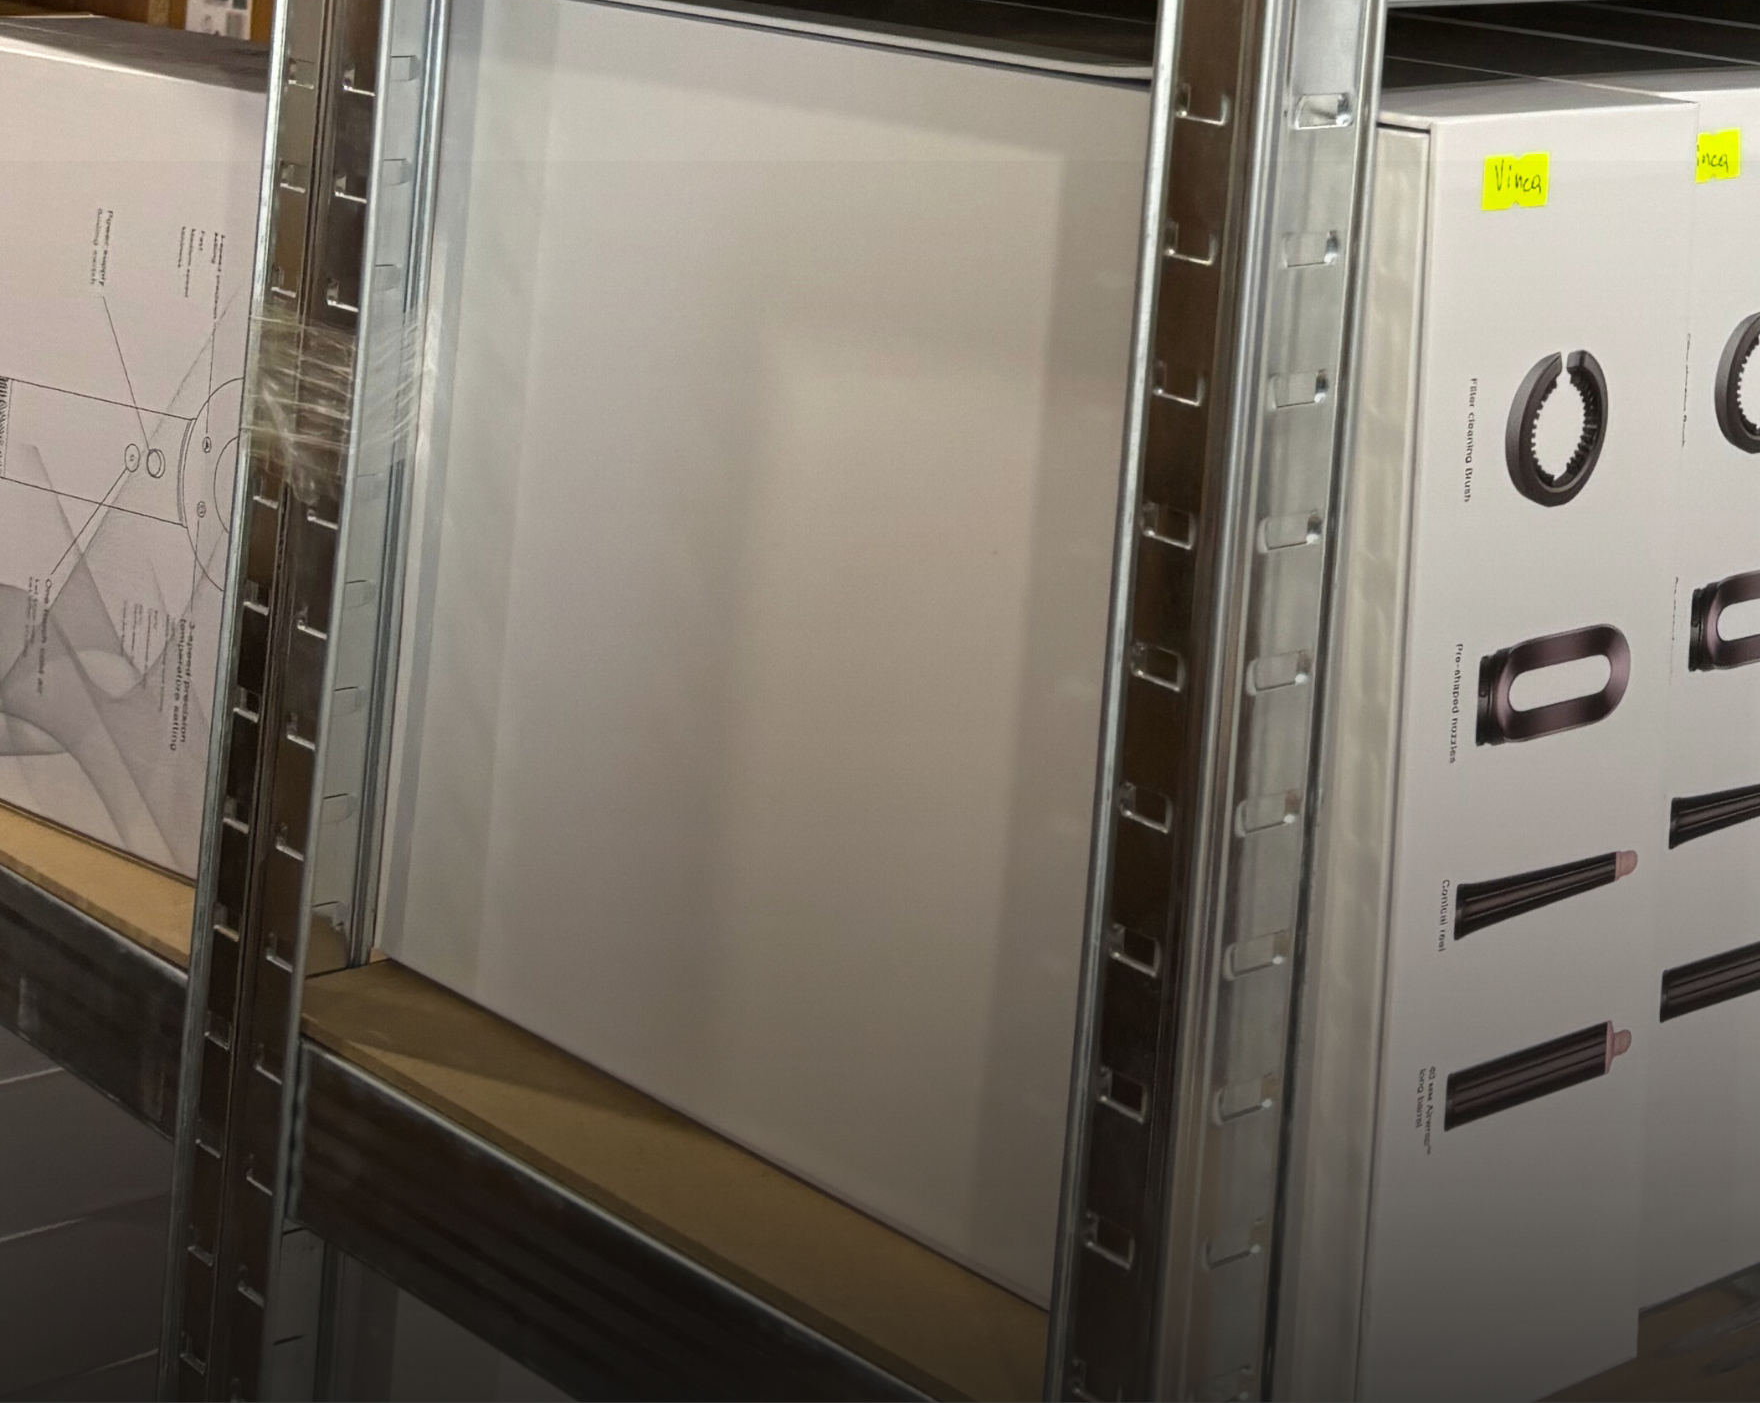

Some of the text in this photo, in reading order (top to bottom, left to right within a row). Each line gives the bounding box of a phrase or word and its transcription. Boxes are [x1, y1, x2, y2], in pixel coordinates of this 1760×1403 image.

[1696, 144, 1729, 173] inca
[1465, 412, 1475, 464] cleaning
[174, 618, 187, 701] temperature
[180, 680, 191, 743] precision
